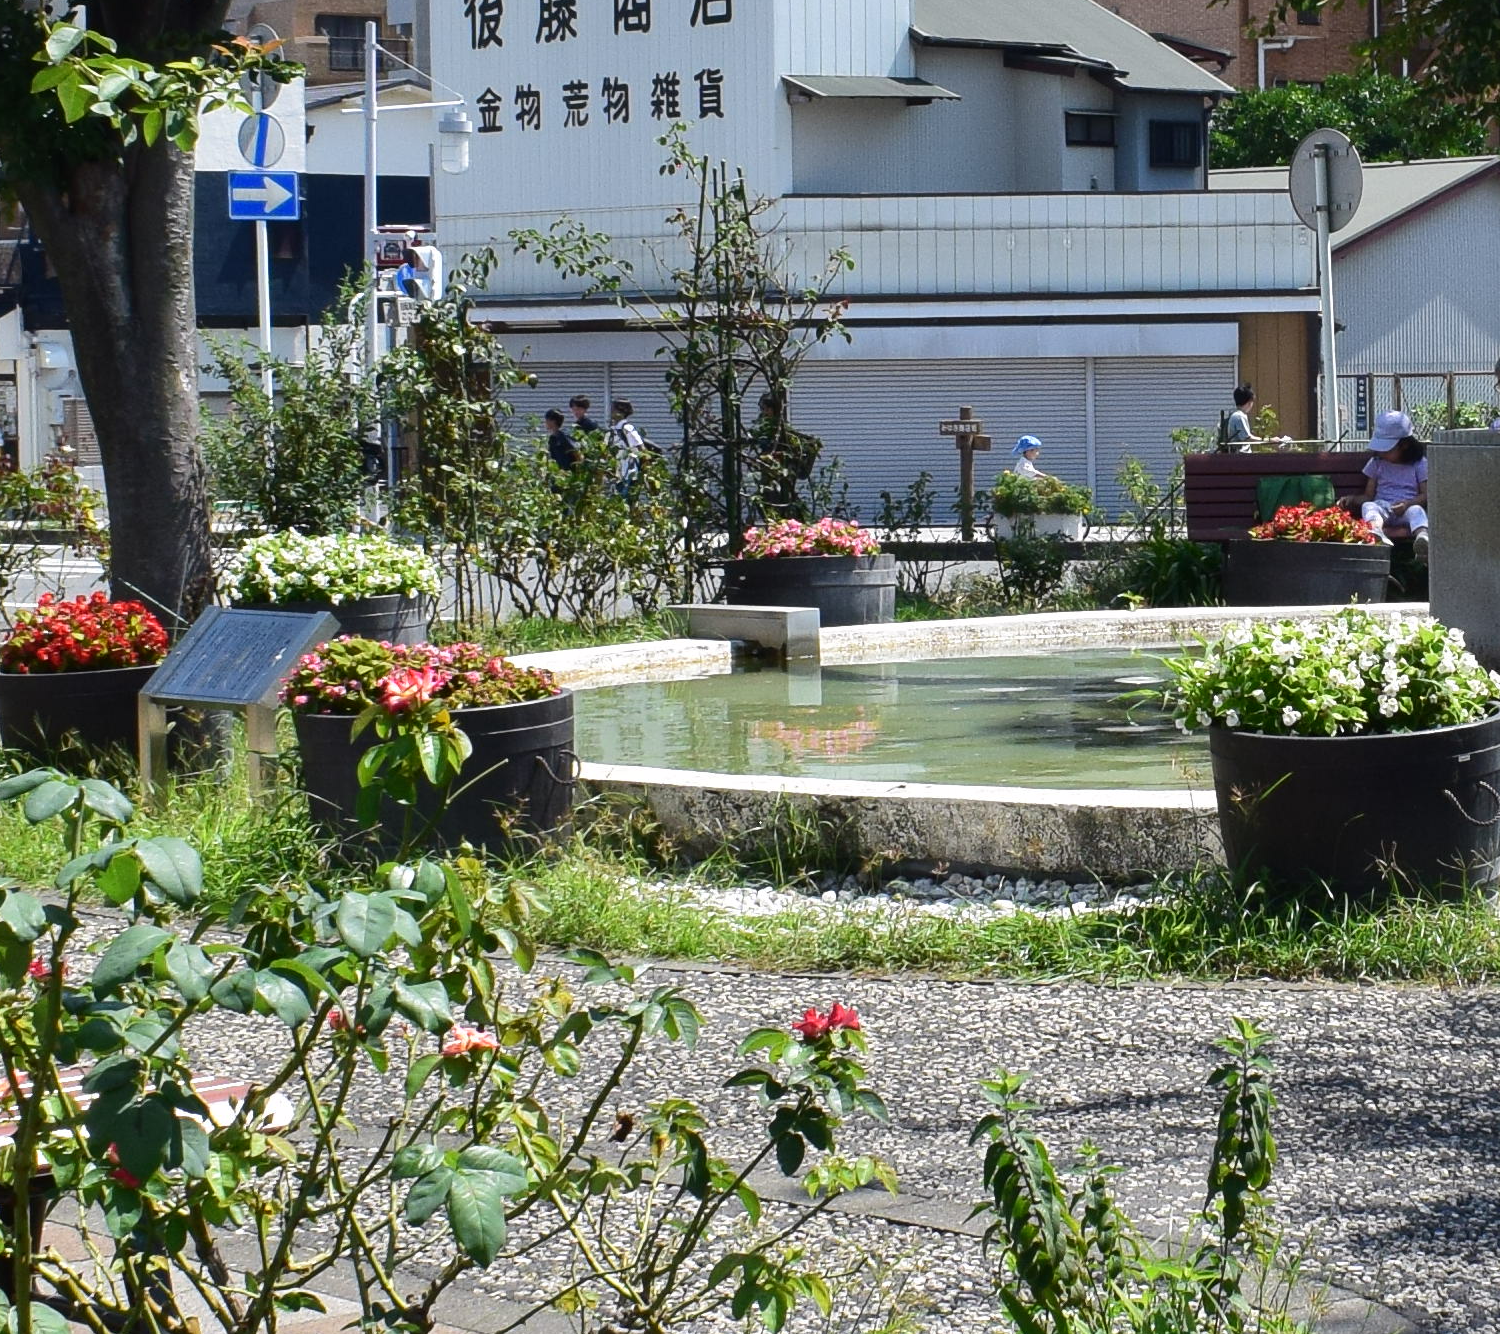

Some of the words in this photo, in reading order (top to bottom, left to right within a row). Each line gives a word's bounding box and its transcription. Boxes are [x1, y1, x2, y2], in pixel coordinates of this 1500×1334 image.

[476, 68, 725, 133] 金物荒物雑貨
